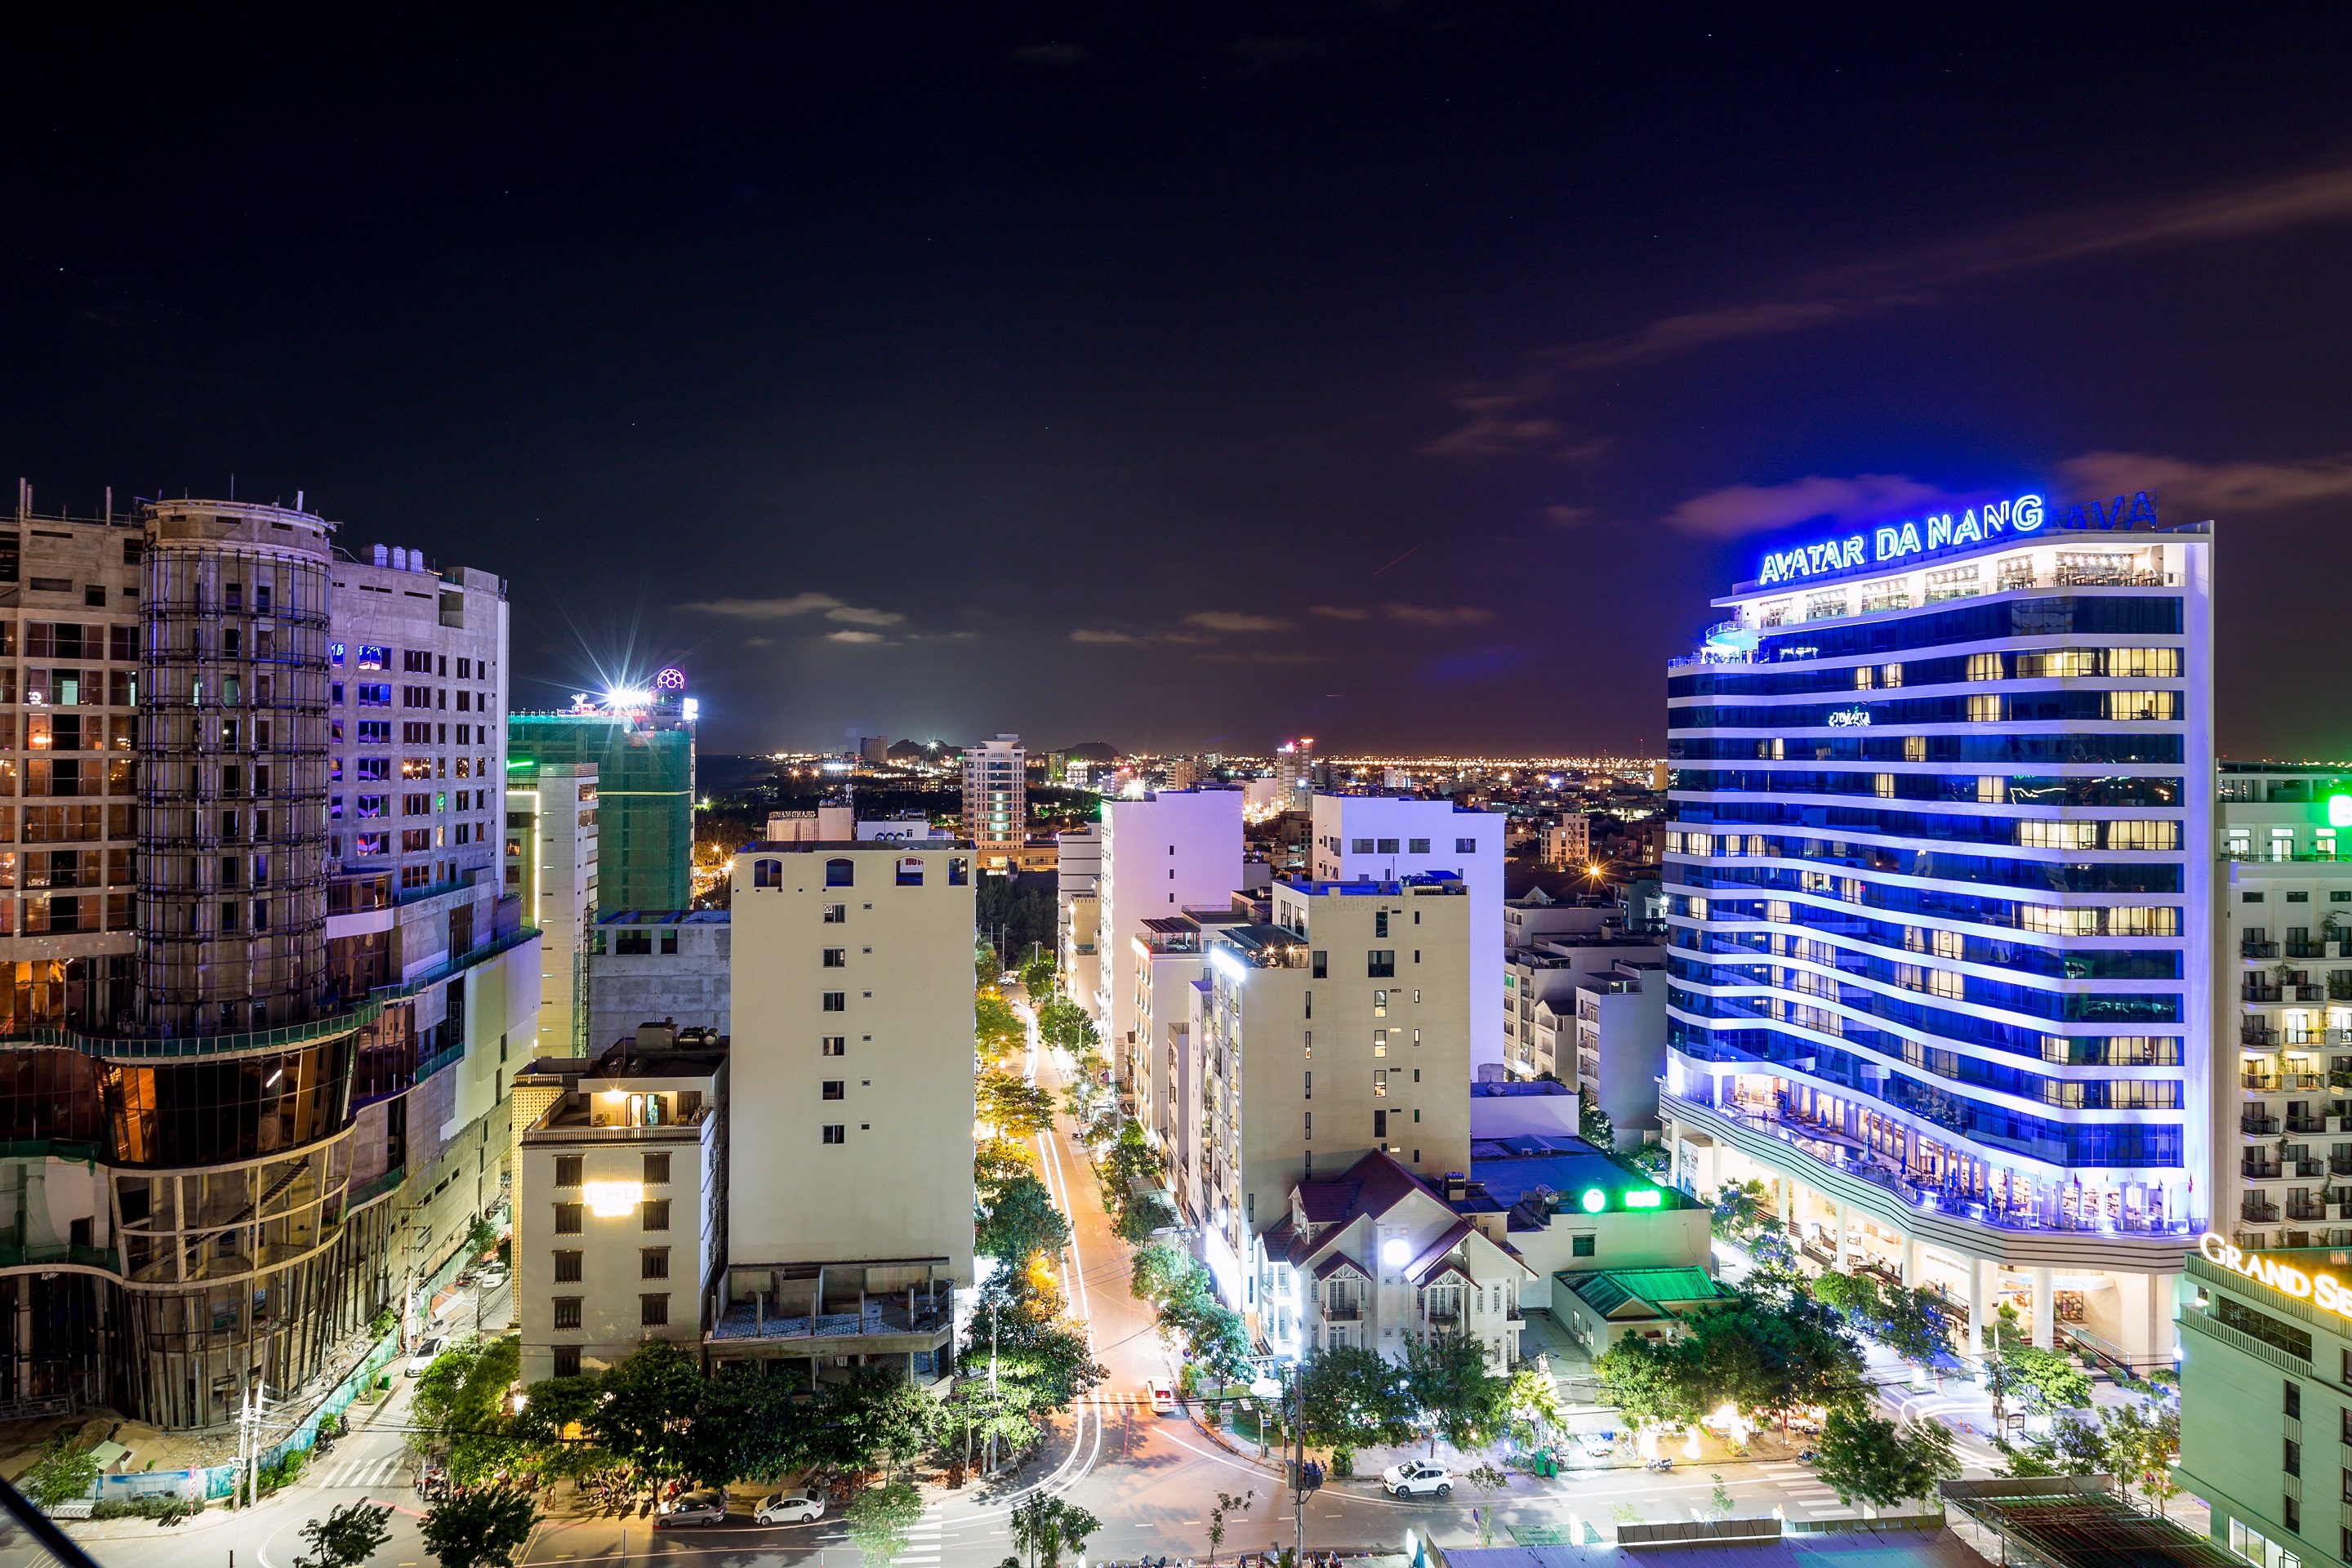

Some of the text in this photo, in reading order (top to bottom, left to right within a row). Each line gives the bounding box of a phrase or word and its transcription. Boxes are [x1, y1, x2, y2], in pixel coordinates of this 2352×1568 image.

[1760, 494, 2042, 585] AVATAR DA NANG
[2199, 1232, 2312, 1298] GRAND
